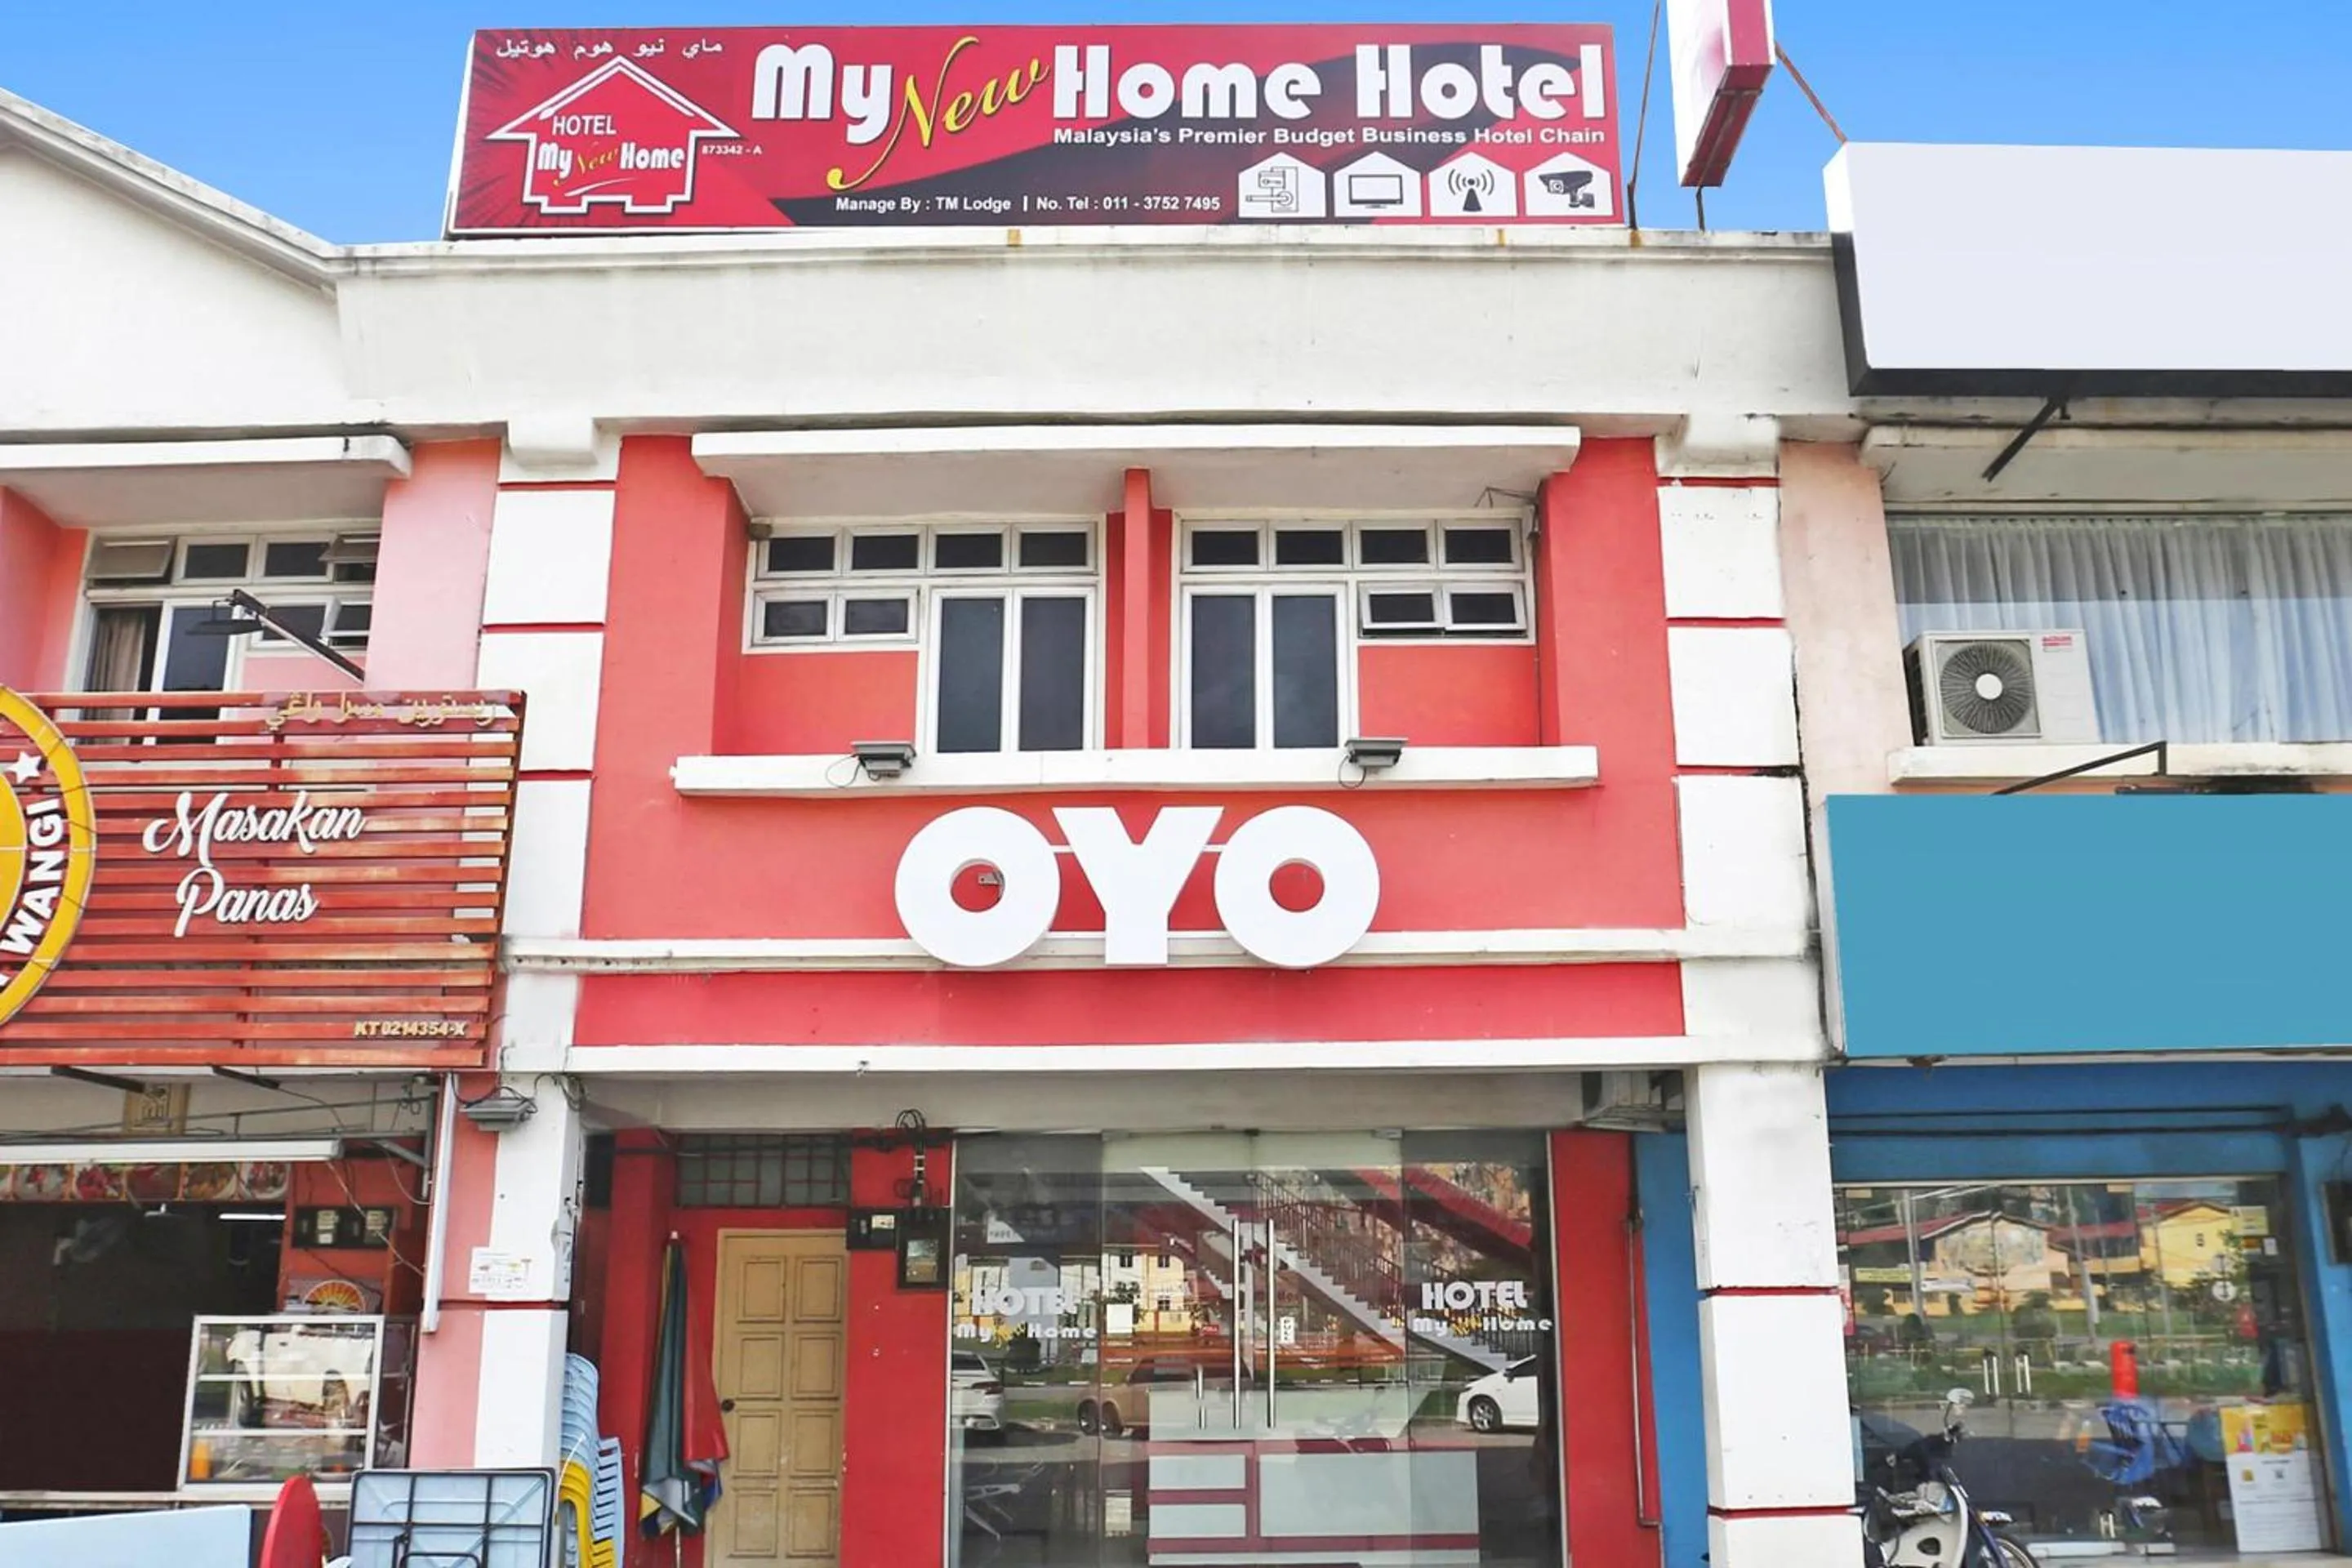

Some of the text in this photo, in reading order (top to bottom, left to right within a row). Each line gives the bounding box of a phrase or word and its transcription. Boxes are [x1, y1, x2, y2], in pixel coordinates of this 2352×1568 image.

[496, 38, 723, 60] ماي نيو هوم هوتيل
[551, 115, 617, 136] HOTEL
[751, 36, 1606, 189] My New Home Hotel
[1054, 127, 1606, 147] Malaysia's Premier Budget Business Hotel Chain
[537, 142, 572, 179] My
[620, 142, 685, 170] Home
[835, 197, 896, 214] Manage
[900, 197, 921, 214] By
[935, 196, 960, 210] TM
[963, 196, 1011, 214] Lodge
[1036, 196, 1063, 211] No.
[1067, 196, 1089, 210] Tel
[1102, 196, 1129, 210] 011
[1143, 196, 1181, 211] 3752
[1184, 196, 1222, 211] 7495
[143, 790, 367, 867] Masakan
[0, 799, 64, 955] WANGI
[894, 805, 1380, 968] OYO
[174, 866, 319, 938] Panas
[973, 1287, 1077, 1316] HOTEL
[1422, 1281, 1527, 1310] HOTEL
[1027, 1322, 1098, 1339] Home
